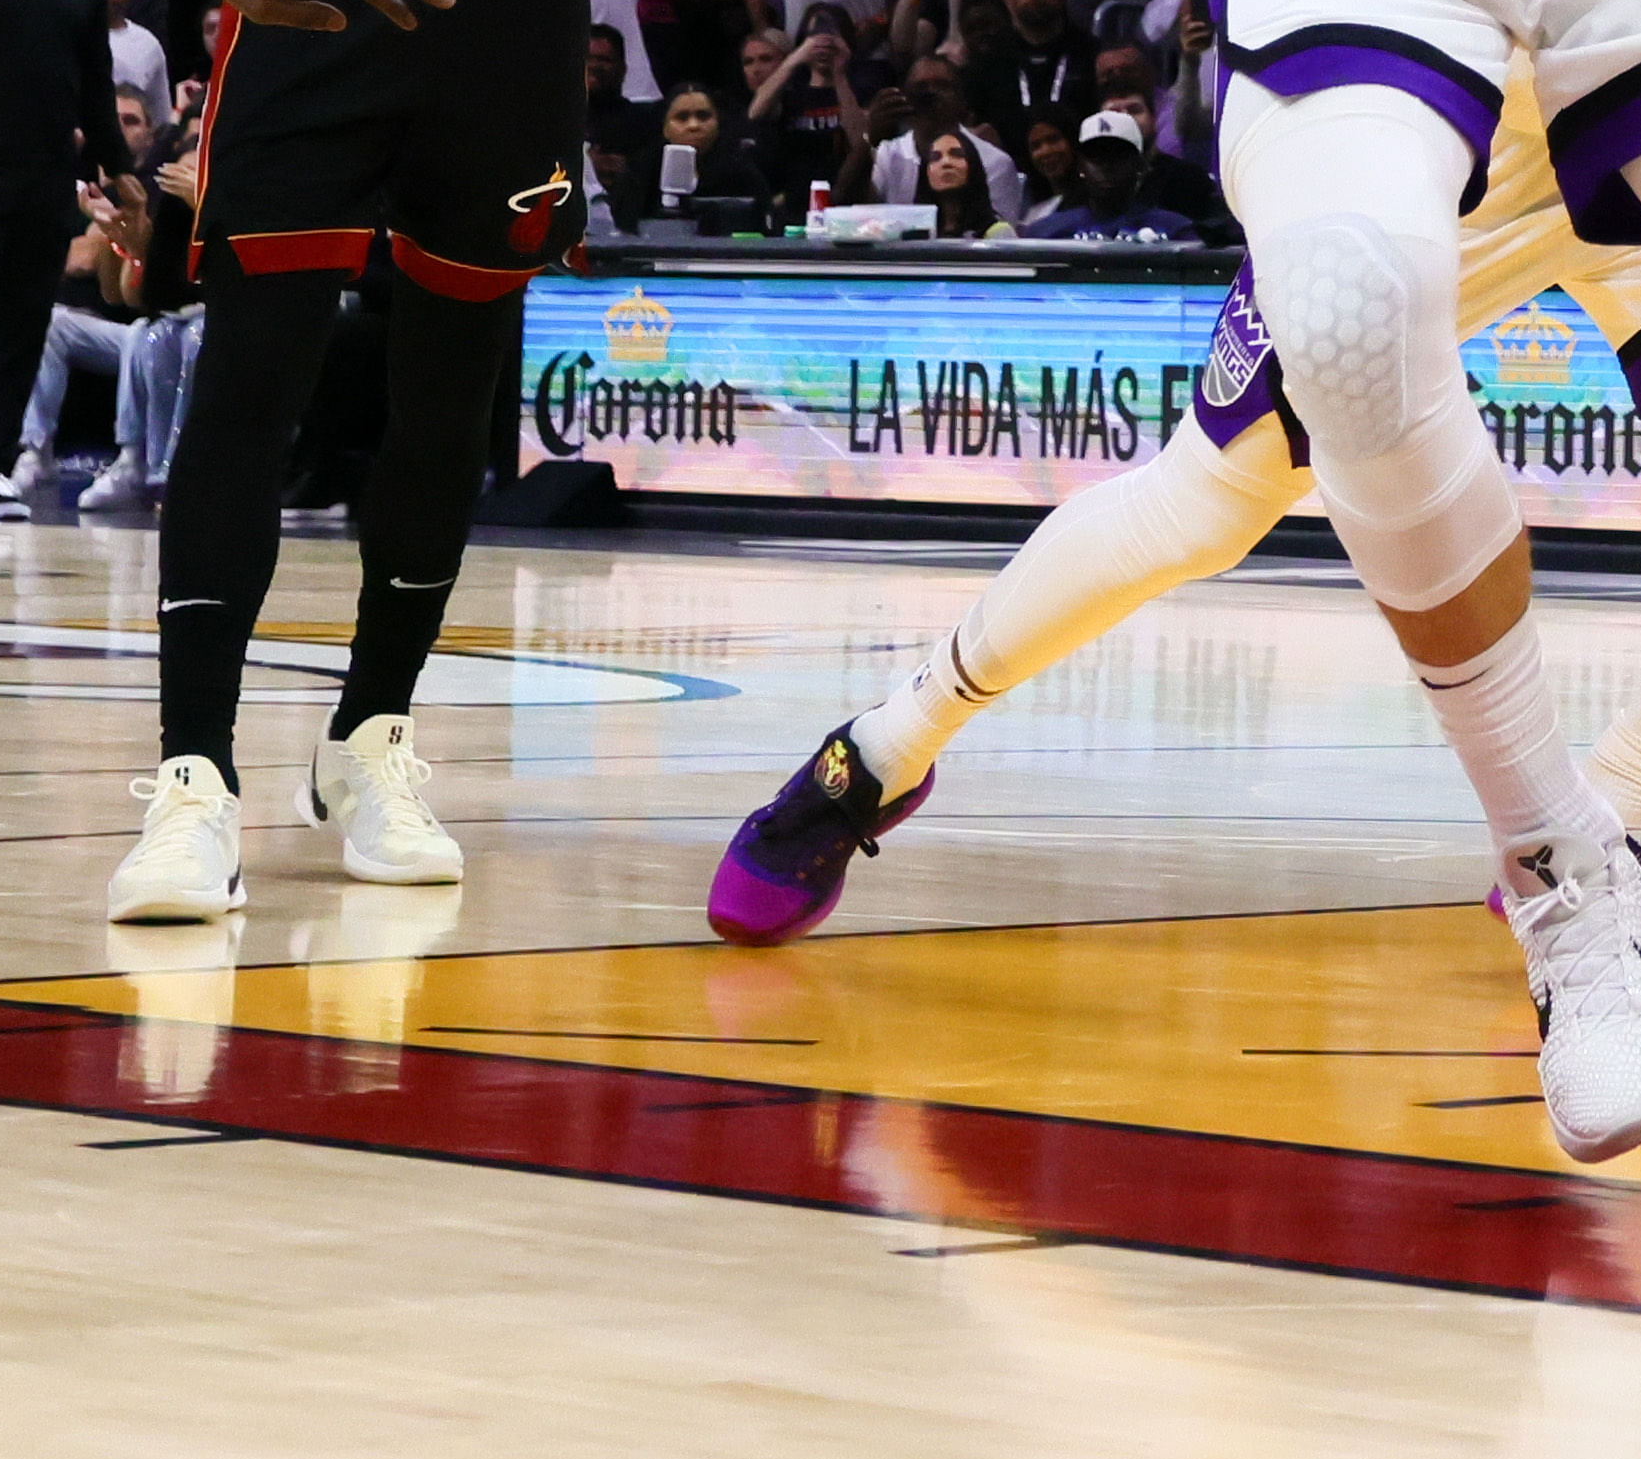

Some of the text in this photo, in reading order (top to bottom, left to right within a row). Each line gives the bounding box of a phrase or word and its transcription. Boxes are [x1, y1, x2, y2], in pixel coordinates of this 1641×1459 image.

[534, 350, 740, 457] Corona
[848, 358, 904, 455] LA
[915, 358, 1022, 459] VIDA
[1040, 349, 1139, 462] MÁS
